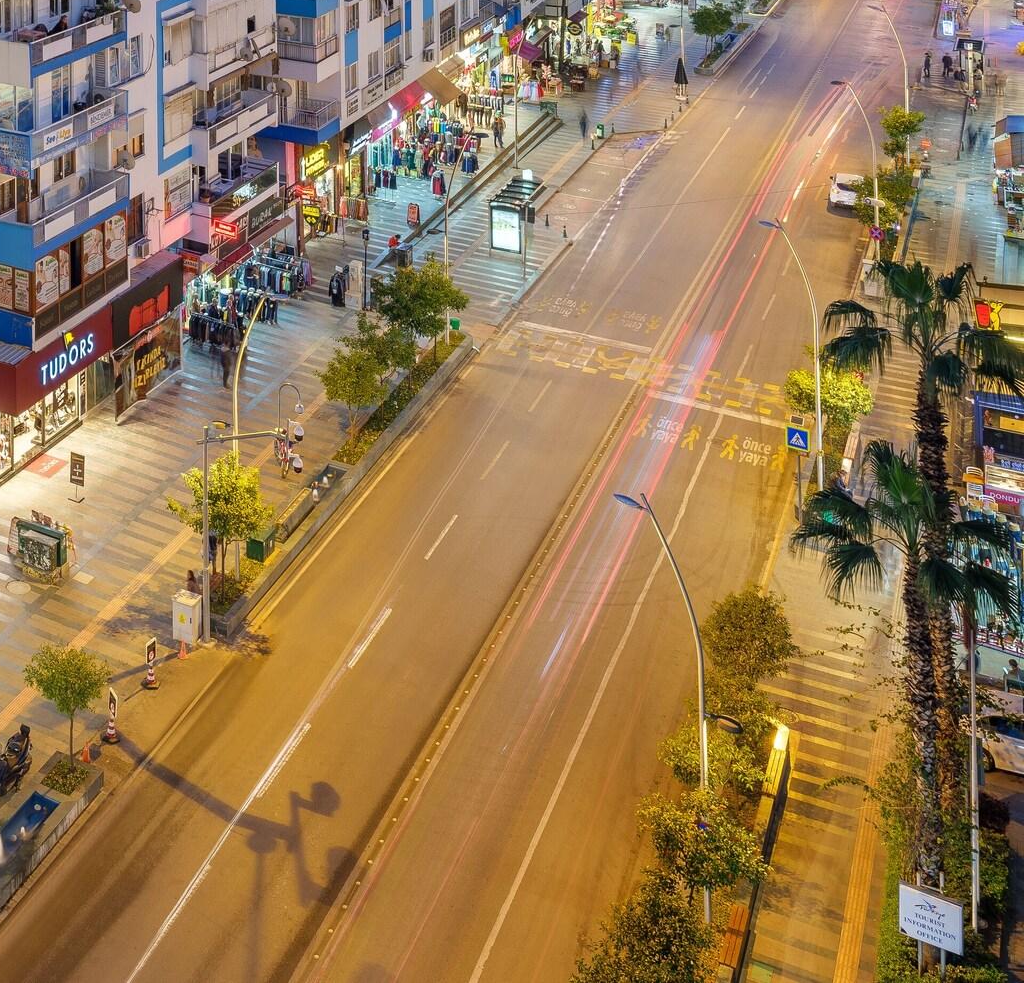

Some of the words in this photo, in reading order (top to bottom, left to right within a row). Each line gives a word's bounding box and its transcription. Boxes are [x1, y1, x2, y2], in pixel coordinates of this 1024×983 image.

[41, 333, 94, 386] TUDORS
[742, 436, 772, 455] önce
[738, 449, 770, 466] yaya
[903, 916, 956, 940] INFORMATION
[914, 912, 945, 928] TOURIST
[916, 929, 943, 944] OFFICE
